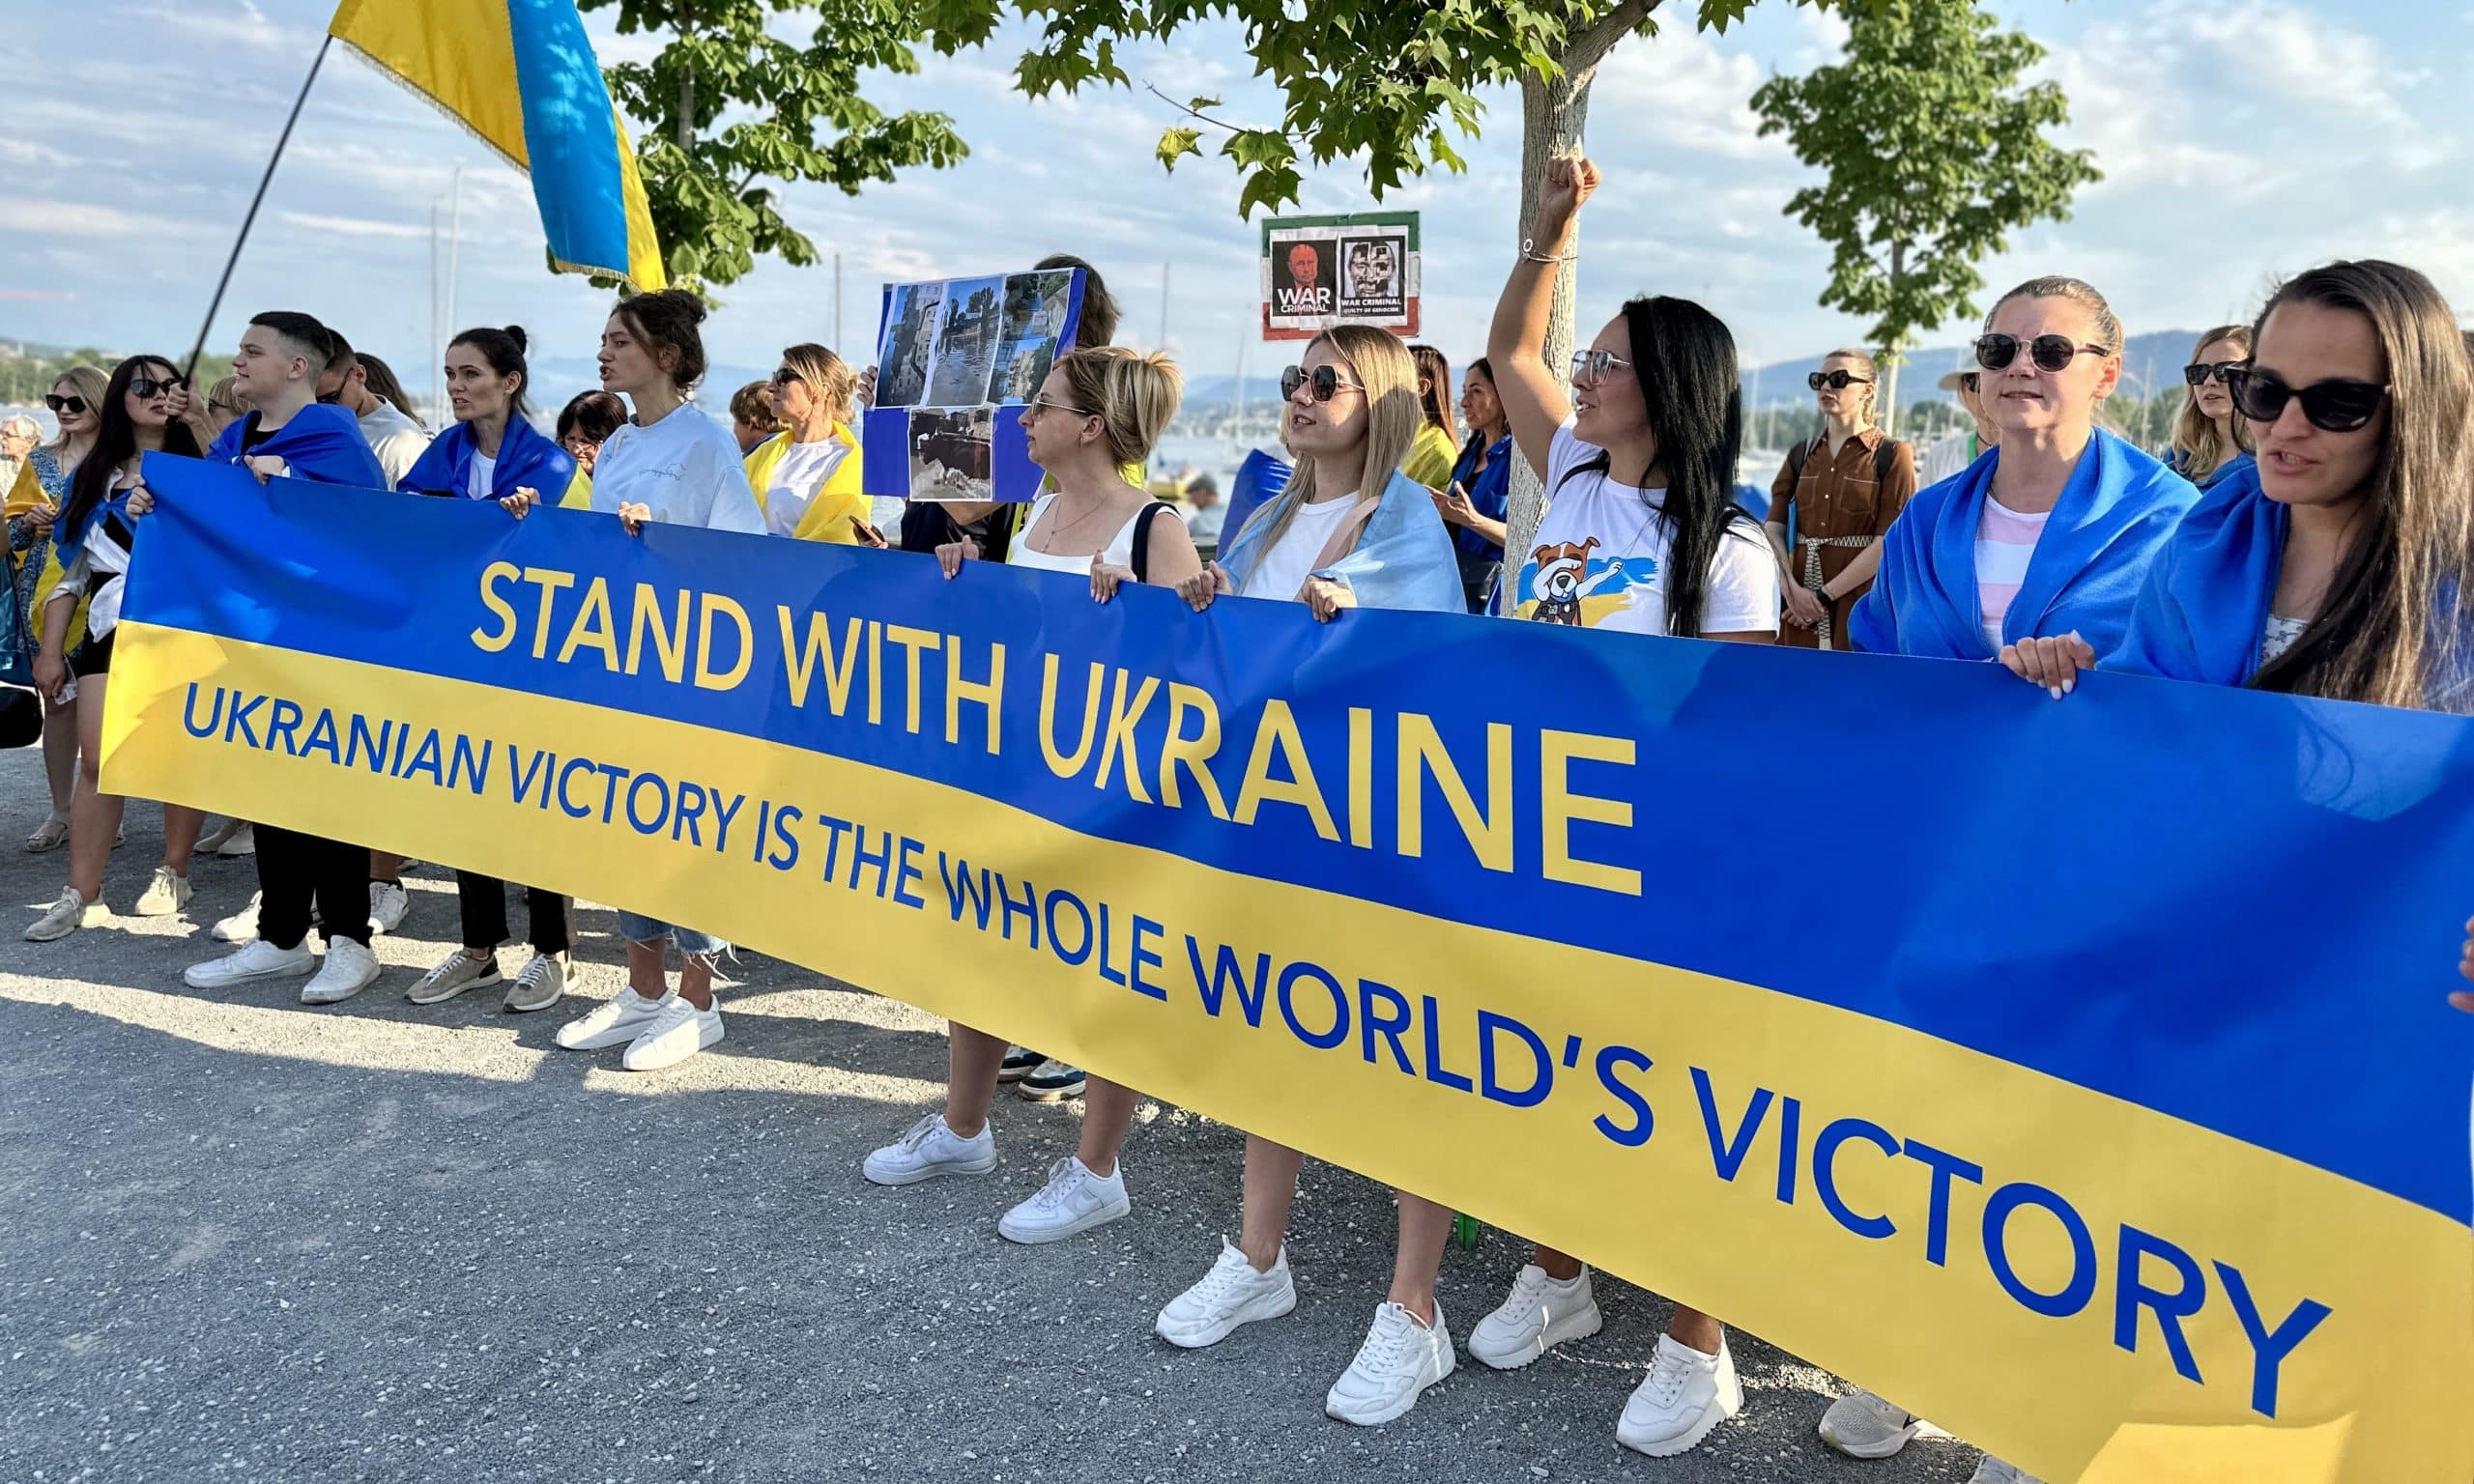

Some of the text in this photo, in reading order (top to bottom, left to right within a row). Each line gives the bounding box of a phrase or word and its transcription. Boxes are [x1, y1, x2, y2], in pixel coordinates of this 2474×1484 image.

[1277, 287, 1331, 304] WAR
[1280, 303, 1330, 313] CRIMINAL
[473, 561, 1644, 897] STAND WITH UKRAINE
[184, 683, 2331, 1419] UKRANIAN VICTORY IS THE WHOLE WORLD'S VICTORY
